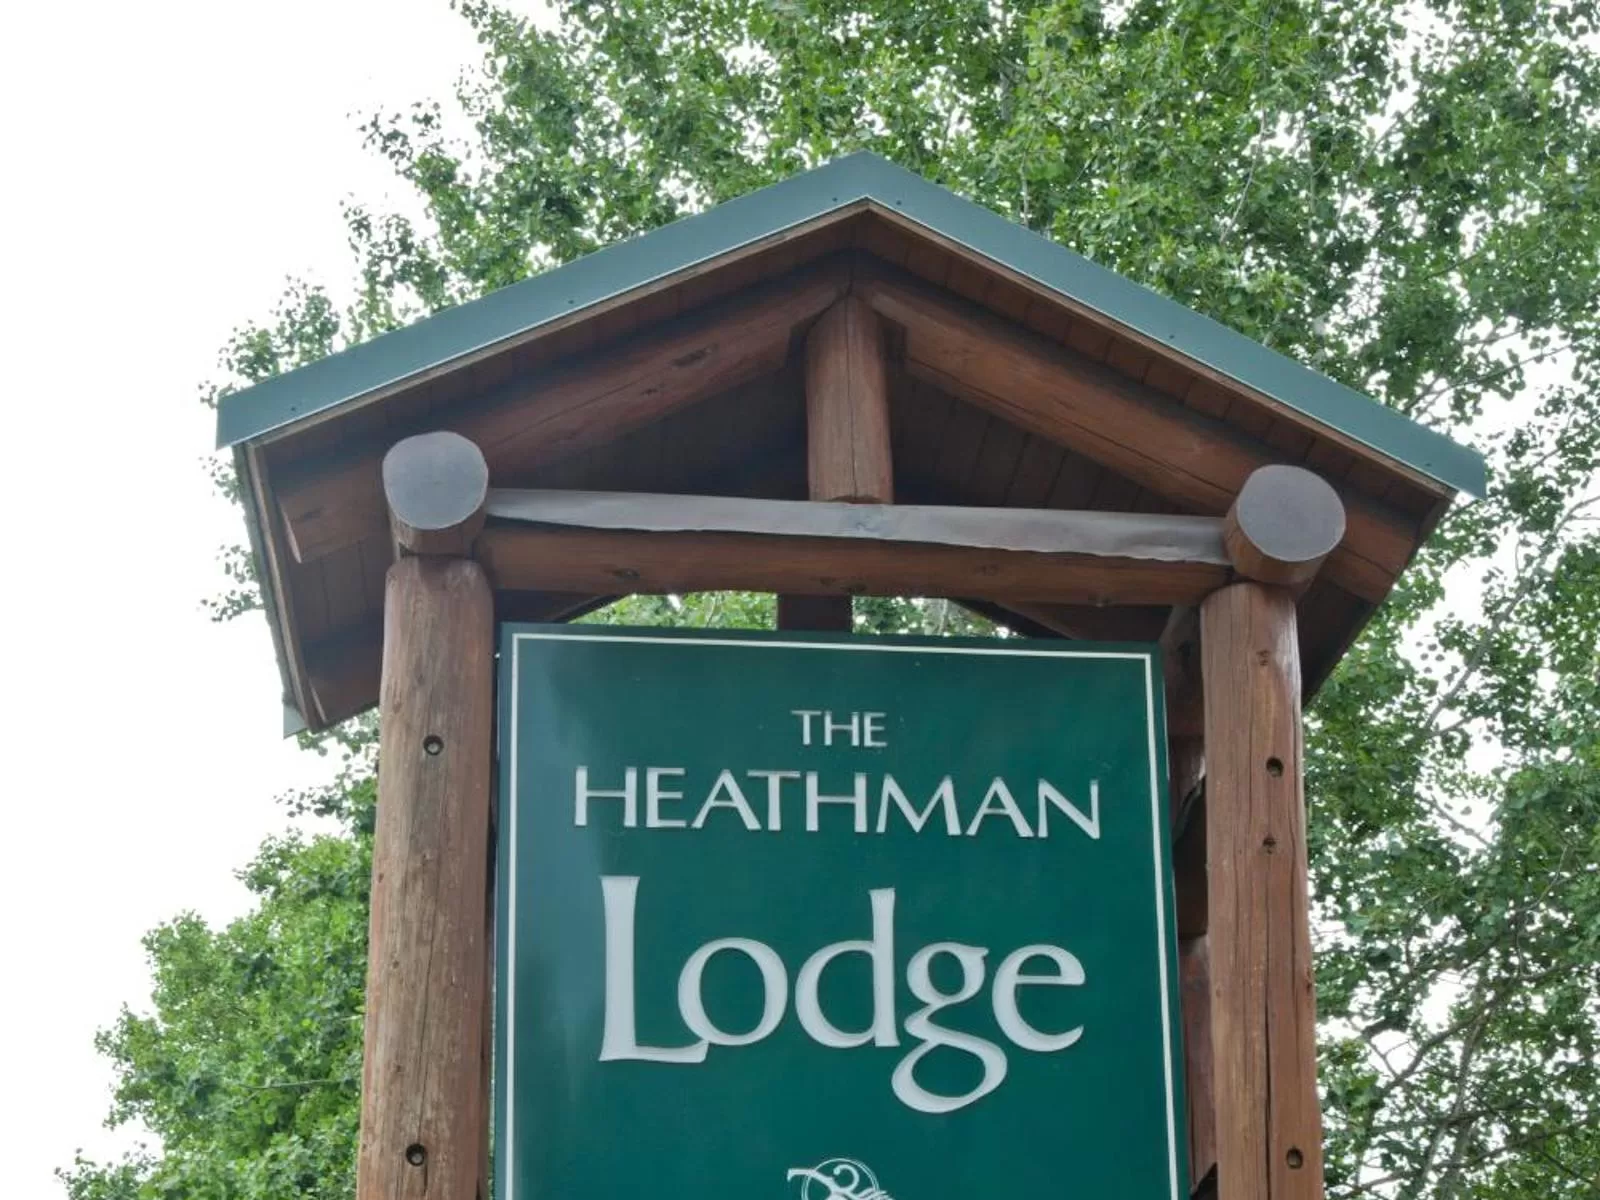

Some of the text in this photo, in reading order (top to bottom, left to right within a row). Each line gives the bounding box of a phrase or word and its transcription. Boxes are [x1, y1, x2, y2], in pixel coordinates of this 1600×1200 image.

[791, 709, 887, 748] THE
[573, 766, 1101, 840] HEATHMAN
[598, 875, 1086, 1114] Lodge
